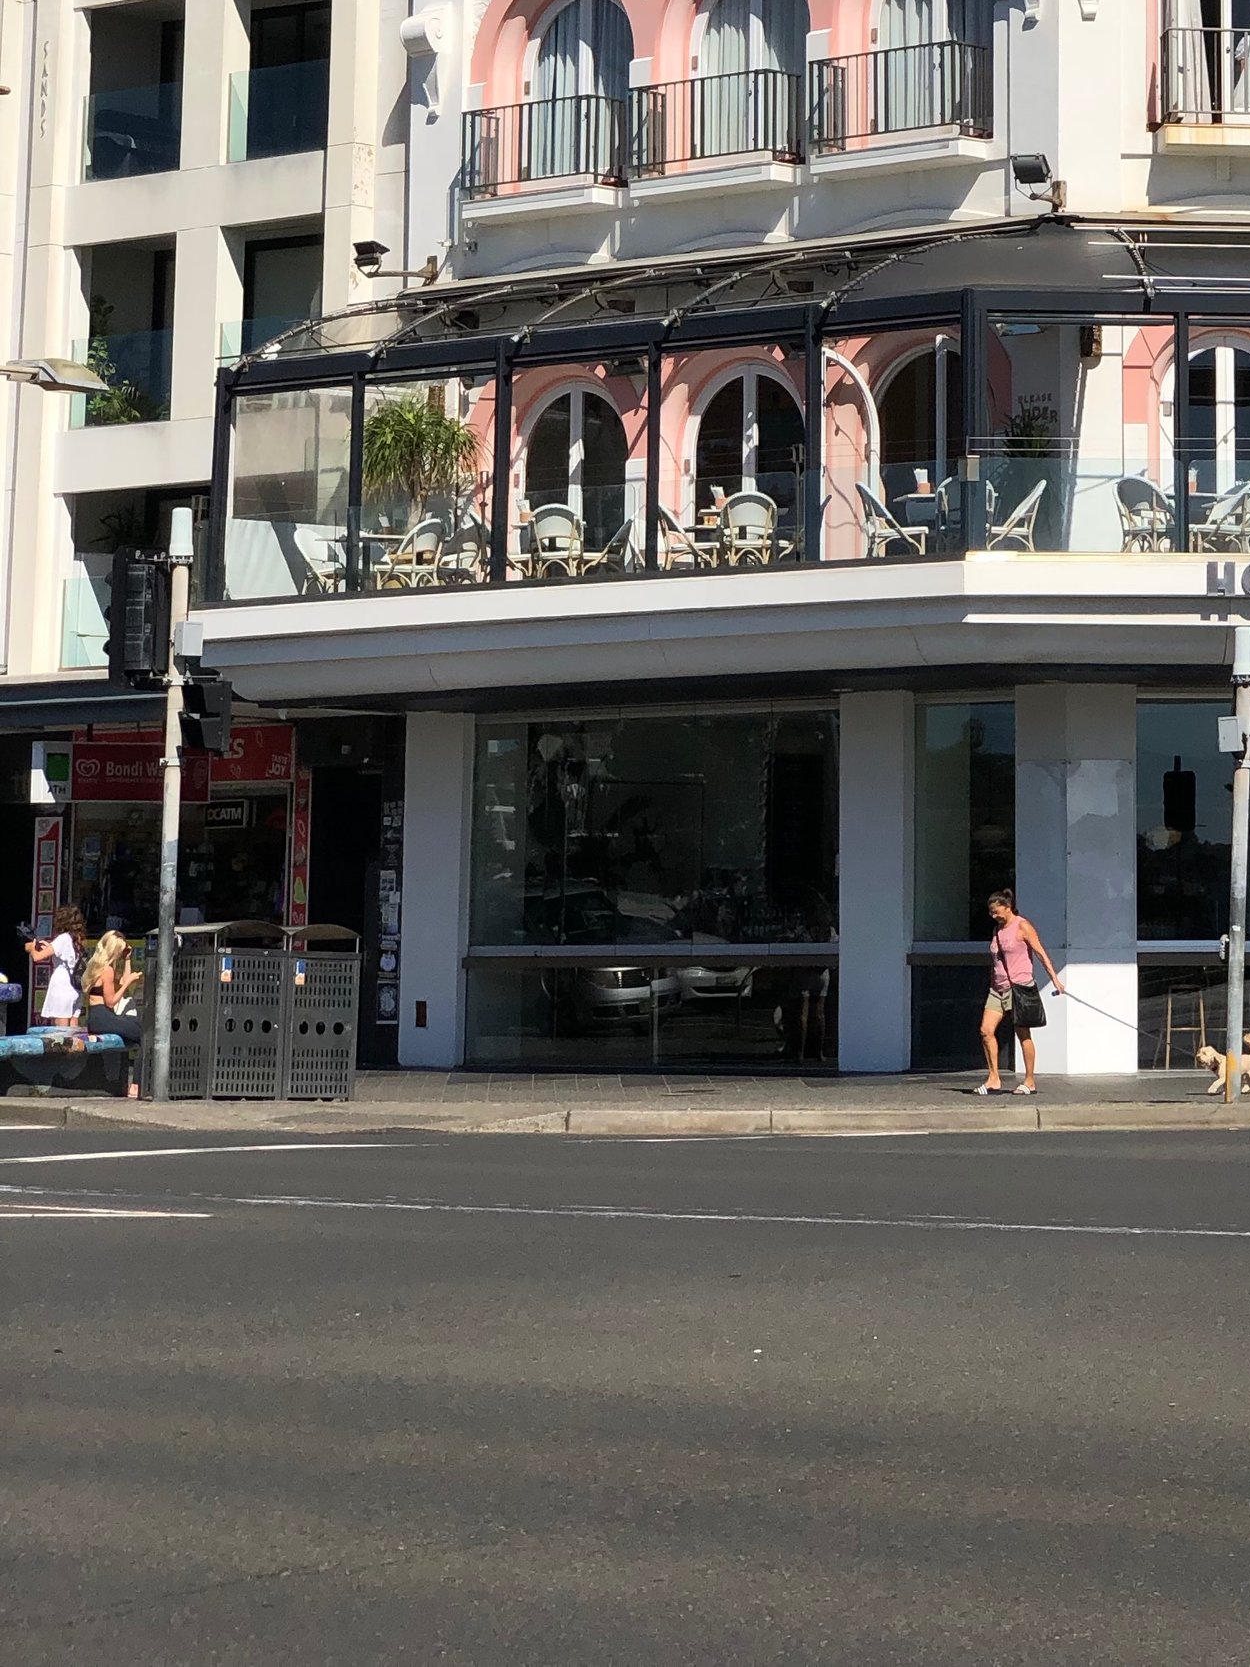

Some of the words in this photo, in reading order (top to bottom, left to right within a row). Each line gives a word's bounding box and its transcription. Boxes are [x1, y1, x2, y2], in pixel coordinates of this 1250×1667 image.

[40, 40, 48, 138] SANDS
[1018, 393, 1052, 403] PLEASE
[106, 760, 143, 776] Bondi
[268, 764, 287, 776] JOY
[47, 784, 66, 795] ATM
